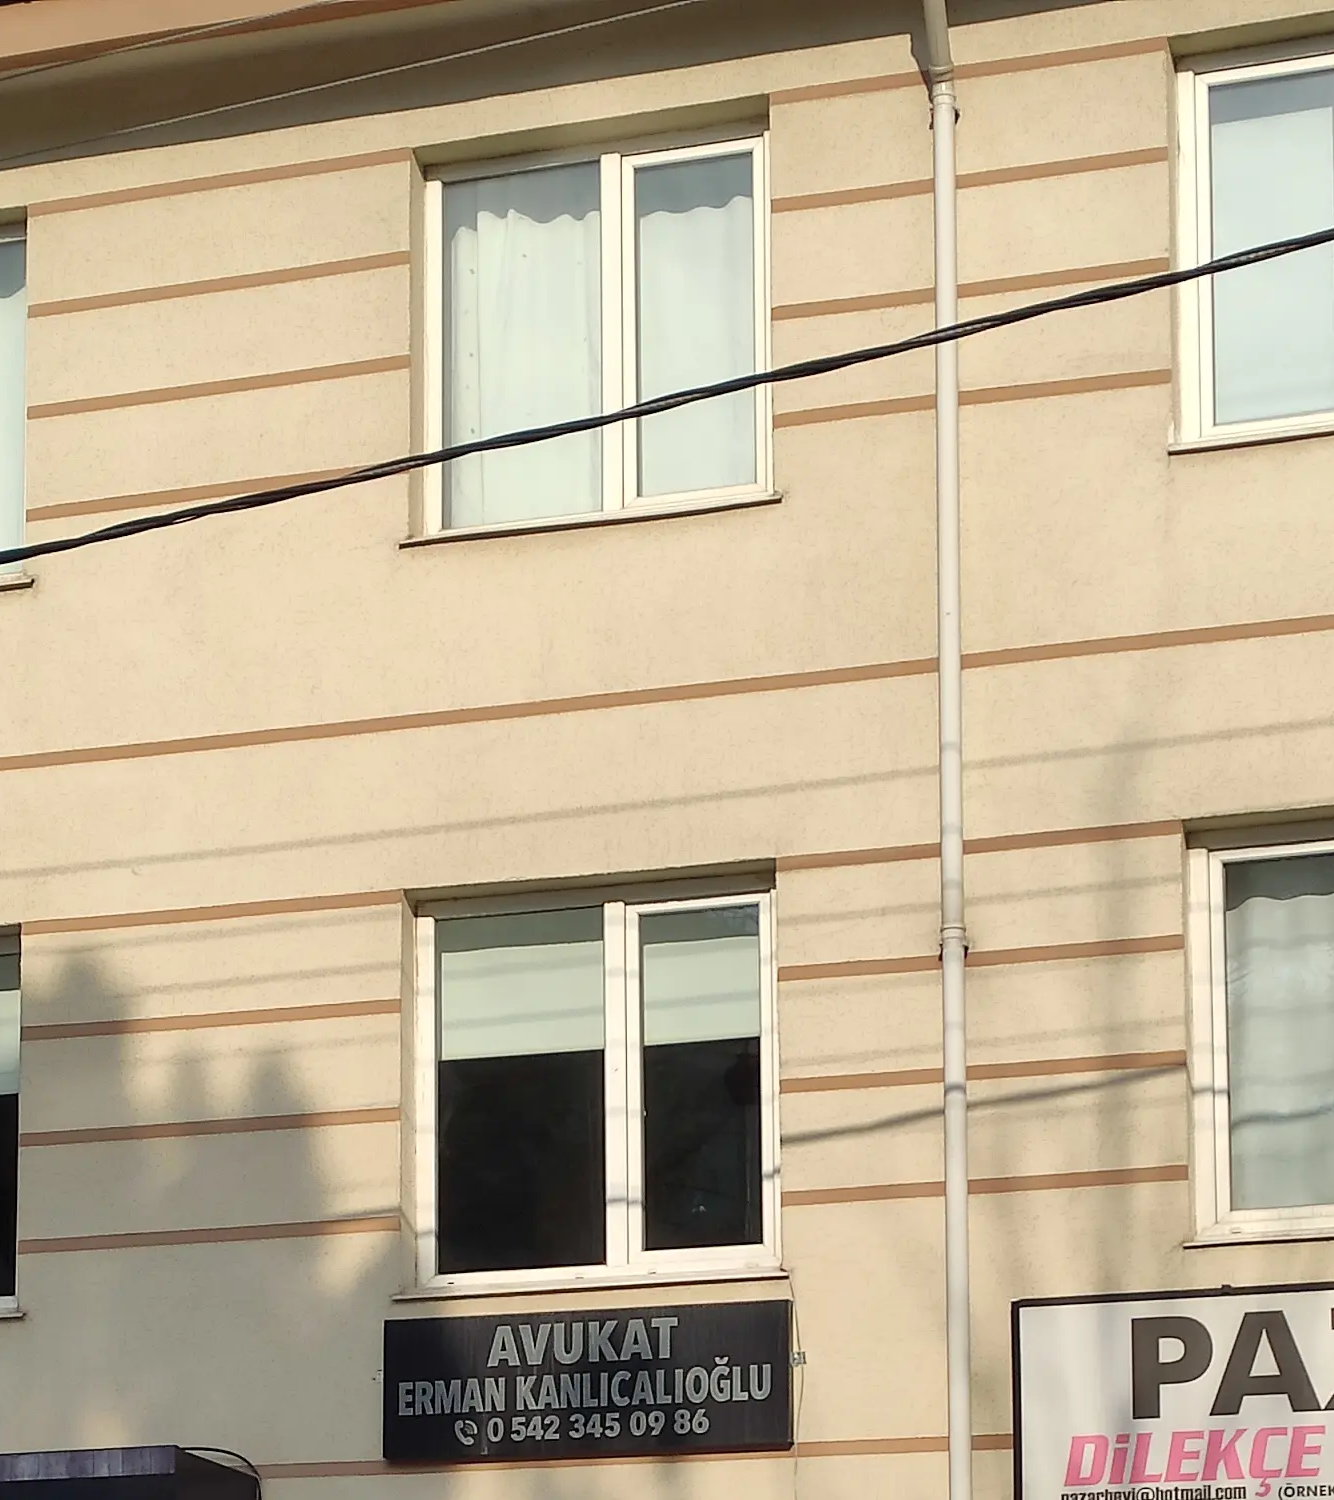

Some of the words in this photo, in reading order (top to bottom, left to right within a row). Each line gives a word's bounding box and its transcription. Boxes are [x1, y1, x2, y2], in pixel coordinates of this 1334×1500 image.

[486, 1315, 679, 1368] AVUKAT
[398, 1377, 505, 1417] ERMAN
[515, 1356, 772, 1412] KANLICALIOĞLU
[487, 1417, 504, 1442] 0
[510, 1415, 561, 1441] 542
[568, 1411, 621, 1440] 345
[628, 1409, 666, 1437] 09
[673, 1408, 710, 1435] 86
